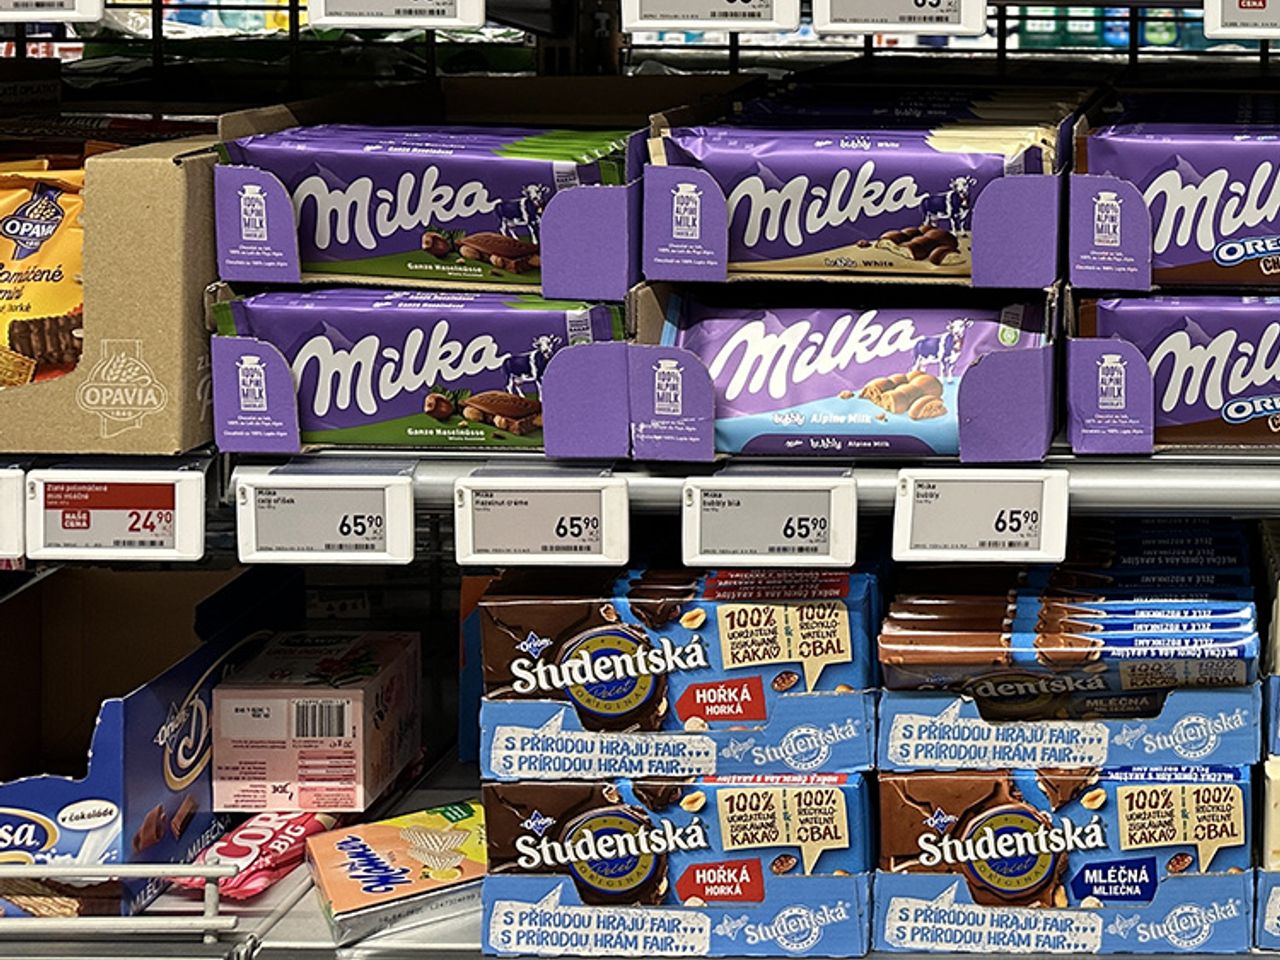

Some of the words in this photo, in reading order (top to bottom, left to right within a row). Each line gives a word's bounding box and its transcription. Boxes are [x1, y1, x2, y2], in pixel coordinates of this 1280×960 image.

[292, 165, 501, 249] Milka
[728, 160, 927, 247] Milka
[863, 259, 894, 267] White
[709, 309, 925, 401] Milka
[292, 320, 511, 417] Milka
[85, 387, 158, 406] OPAVIA
[810, 413, 846, 426] Alpine
[849, 413, 871, 423] Milk
[64, 520, 88, 528] CENA
[512, 635, 707, 693] Studentská
[696, 686, 752, 705] HOŘKÁ
[705, 703, 743, 715] HORKÁ
[505, 737, 515, 751] S
[752, 720, 861, 765] Studentská
[503, 756, 513, 770] S
[599, 757, 643, 772] HRÁM
[1125, 788, 1173, 811] 100%
[1192, 787, 1235, 804] 100%
[270, 824, 306, 855] BIG
[516, 818, 707, 870] Studentská
[918, 815, 1106, 866] Studentská
[695, 866, 751, 884] HOŘKÁ
[1084, 864, 1149, 883] MLÉČNÁ
